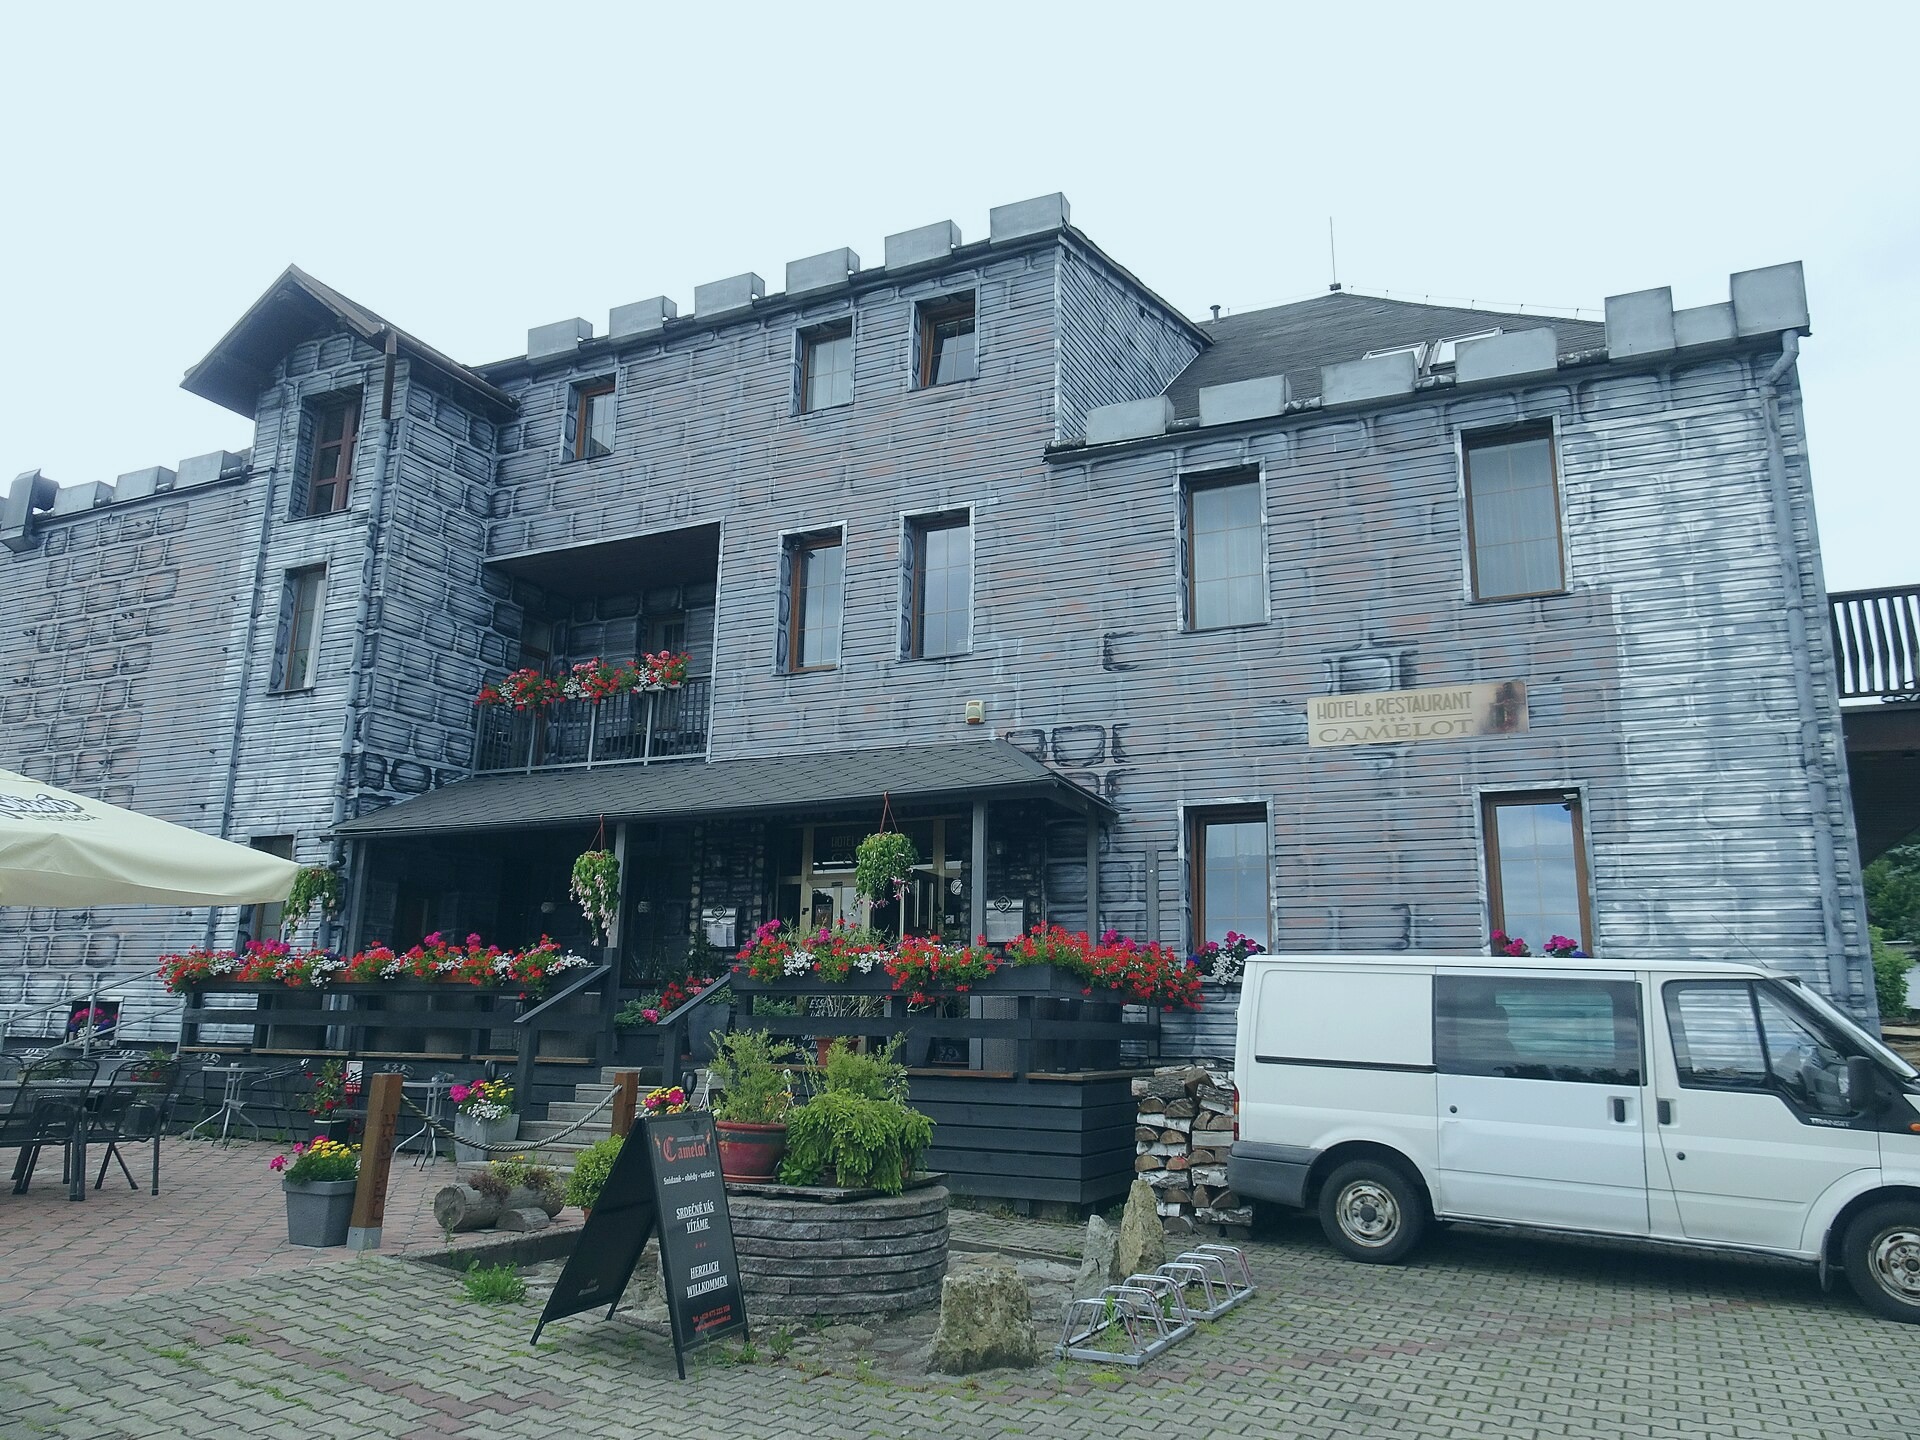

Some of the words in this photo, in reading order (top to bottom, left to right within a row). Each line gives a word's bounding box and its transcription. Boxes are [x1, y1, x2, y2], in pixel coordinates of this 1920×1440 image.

[1316, 700, 1363, 720] HOTEL
[1376, 691, 1473, 715] RESTAURANT
[1318, 719, 1474, 743] CAMELOT
[1809, 1117, 1851, 1127] TRANSIT
[663, 1136, 707, 1162] Camelot
[703, 1200, 715, 1214] VÁS
[690, 1260, 720, 1279] HERZLICH
[686, 1275, 728, 1298] WILLKOMMEN
